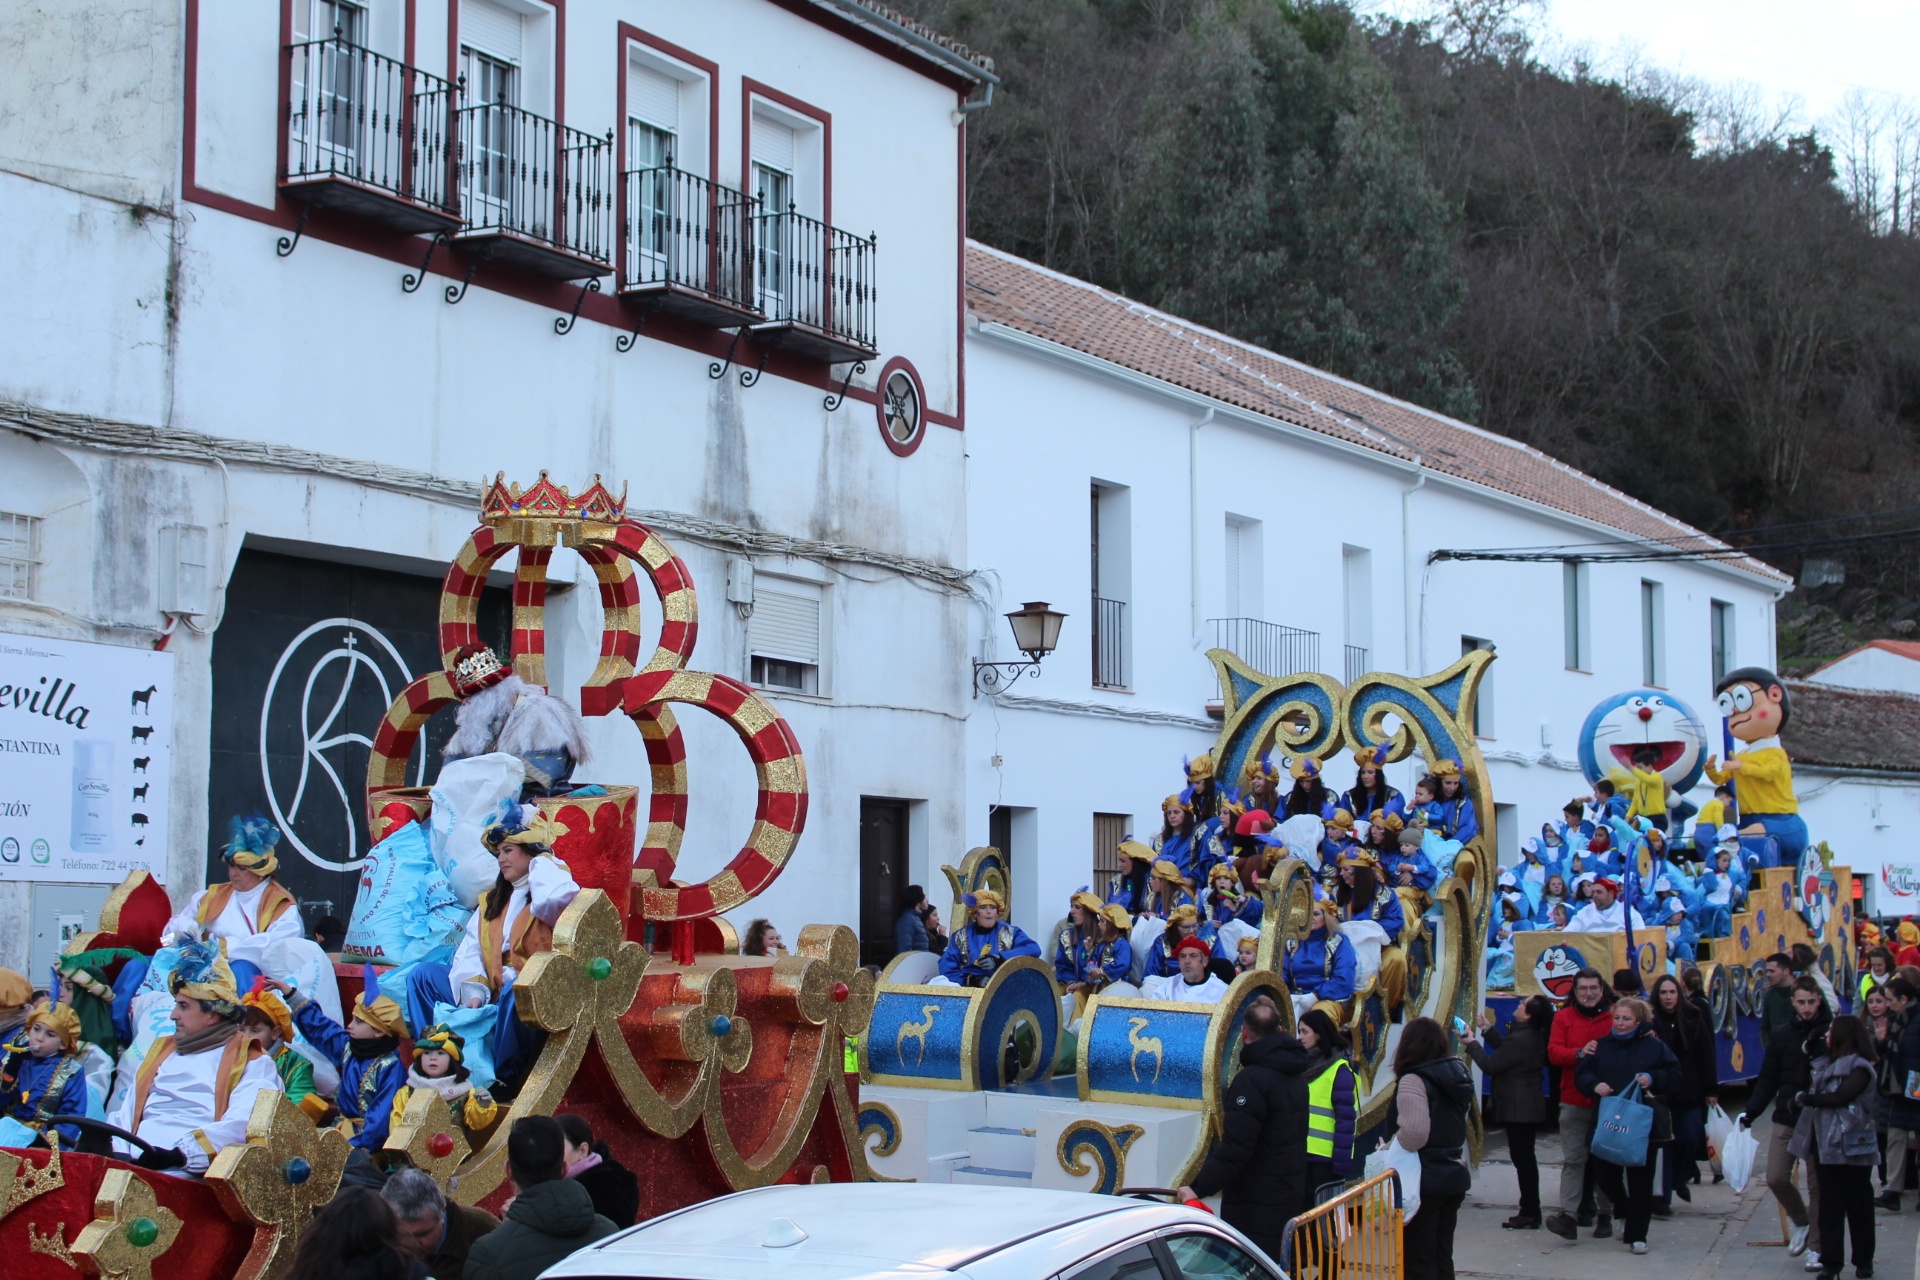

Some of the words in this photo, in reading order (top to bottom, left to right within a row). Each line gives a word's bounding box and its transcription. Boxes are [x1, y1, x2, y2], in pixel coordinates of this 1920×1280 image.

[0, 676, 90, 730] evilla
[0, 739, 61, 755] STANTINA
[61, 858, 99, 870] Teléfono:
[101, 860, 116, 871] 722
[118, 860, 128, 871] 44
